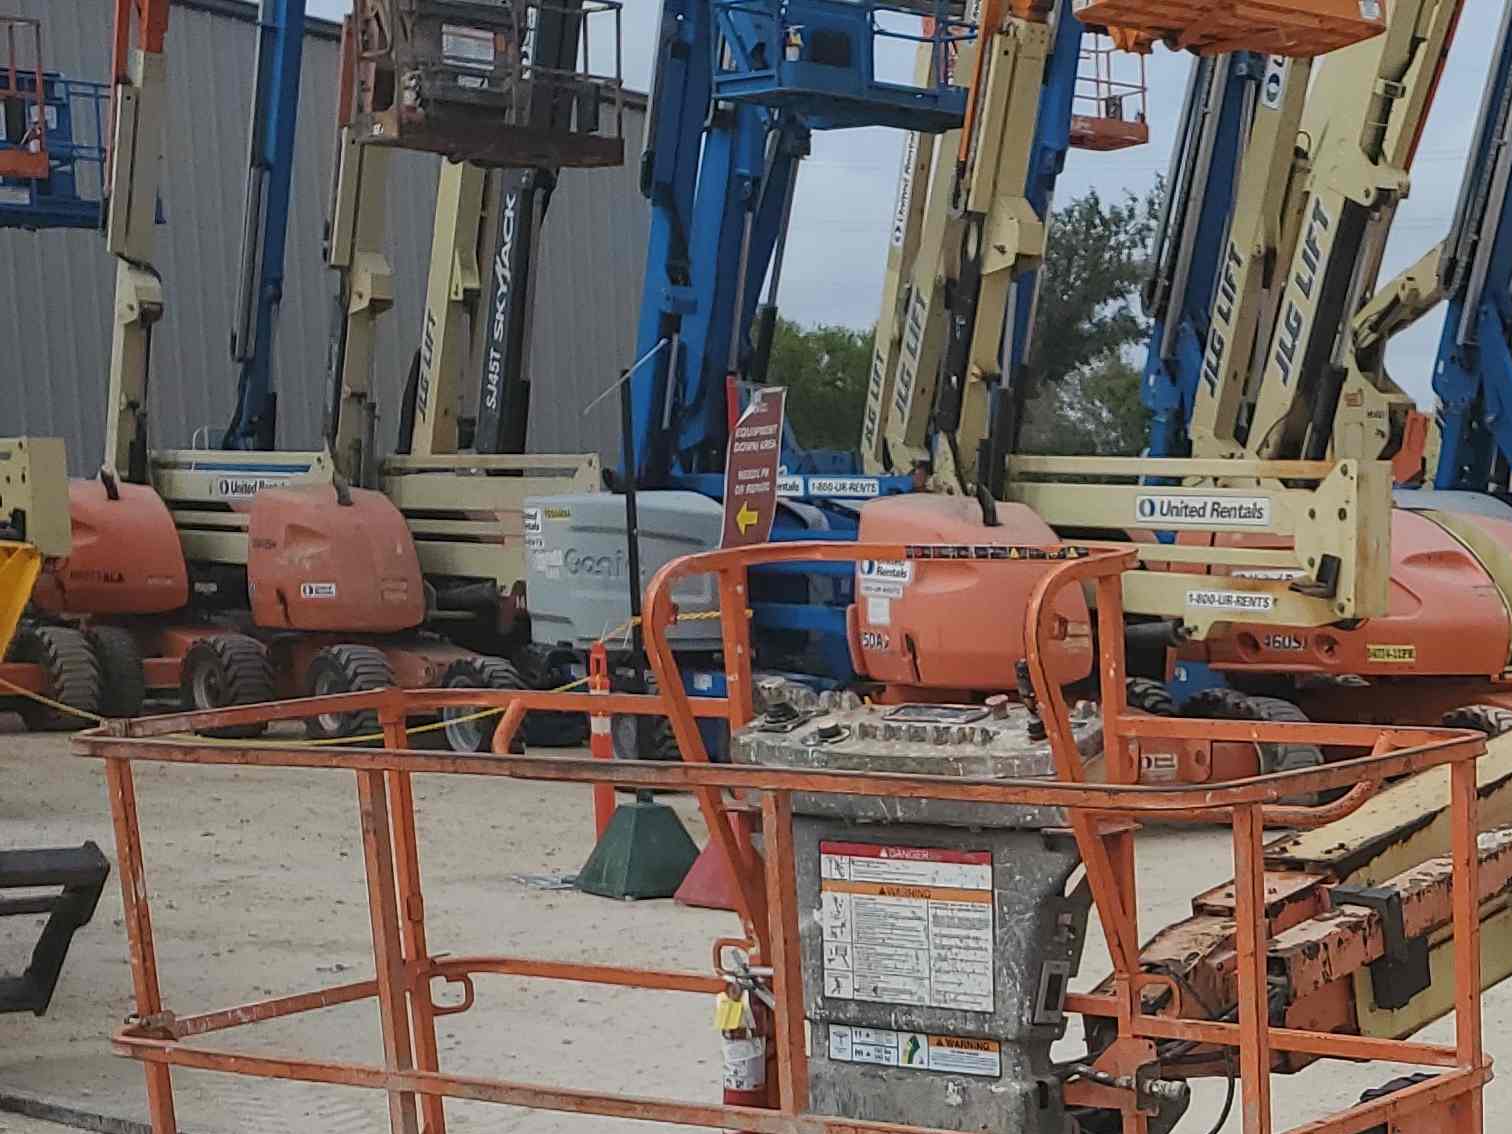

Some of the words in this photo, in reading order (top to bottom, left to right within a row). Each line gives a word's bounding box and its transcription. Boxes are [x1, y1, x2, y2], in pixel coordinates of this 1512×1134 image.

[493, 193, 517, 342] SKYJACK
[1275, 301, 1303, 387] JLG
[1295, 197, 1329, 299] LIFT
[424, 312, 438, 365] LIFT
[1204, 328, 1225, 398] JLG
[1217, 240, 1243, 326] LIFT
[486, 347, 501, 409] SJ45T
[895, 365, 913, 422] JLG
[906, 287, 927, 354] LIFT
[418, 374, 431, 422] JLG
[1159, 499, 1208, 519] United
[1209, 500, 1264, 520] Rentals
[877, 566, 907, 578] Rentals
[888, 848, 929, 859] DANGER
[886, 887, 932, 899] WARNING
[945, 1039, 990, 1051] WARNING
